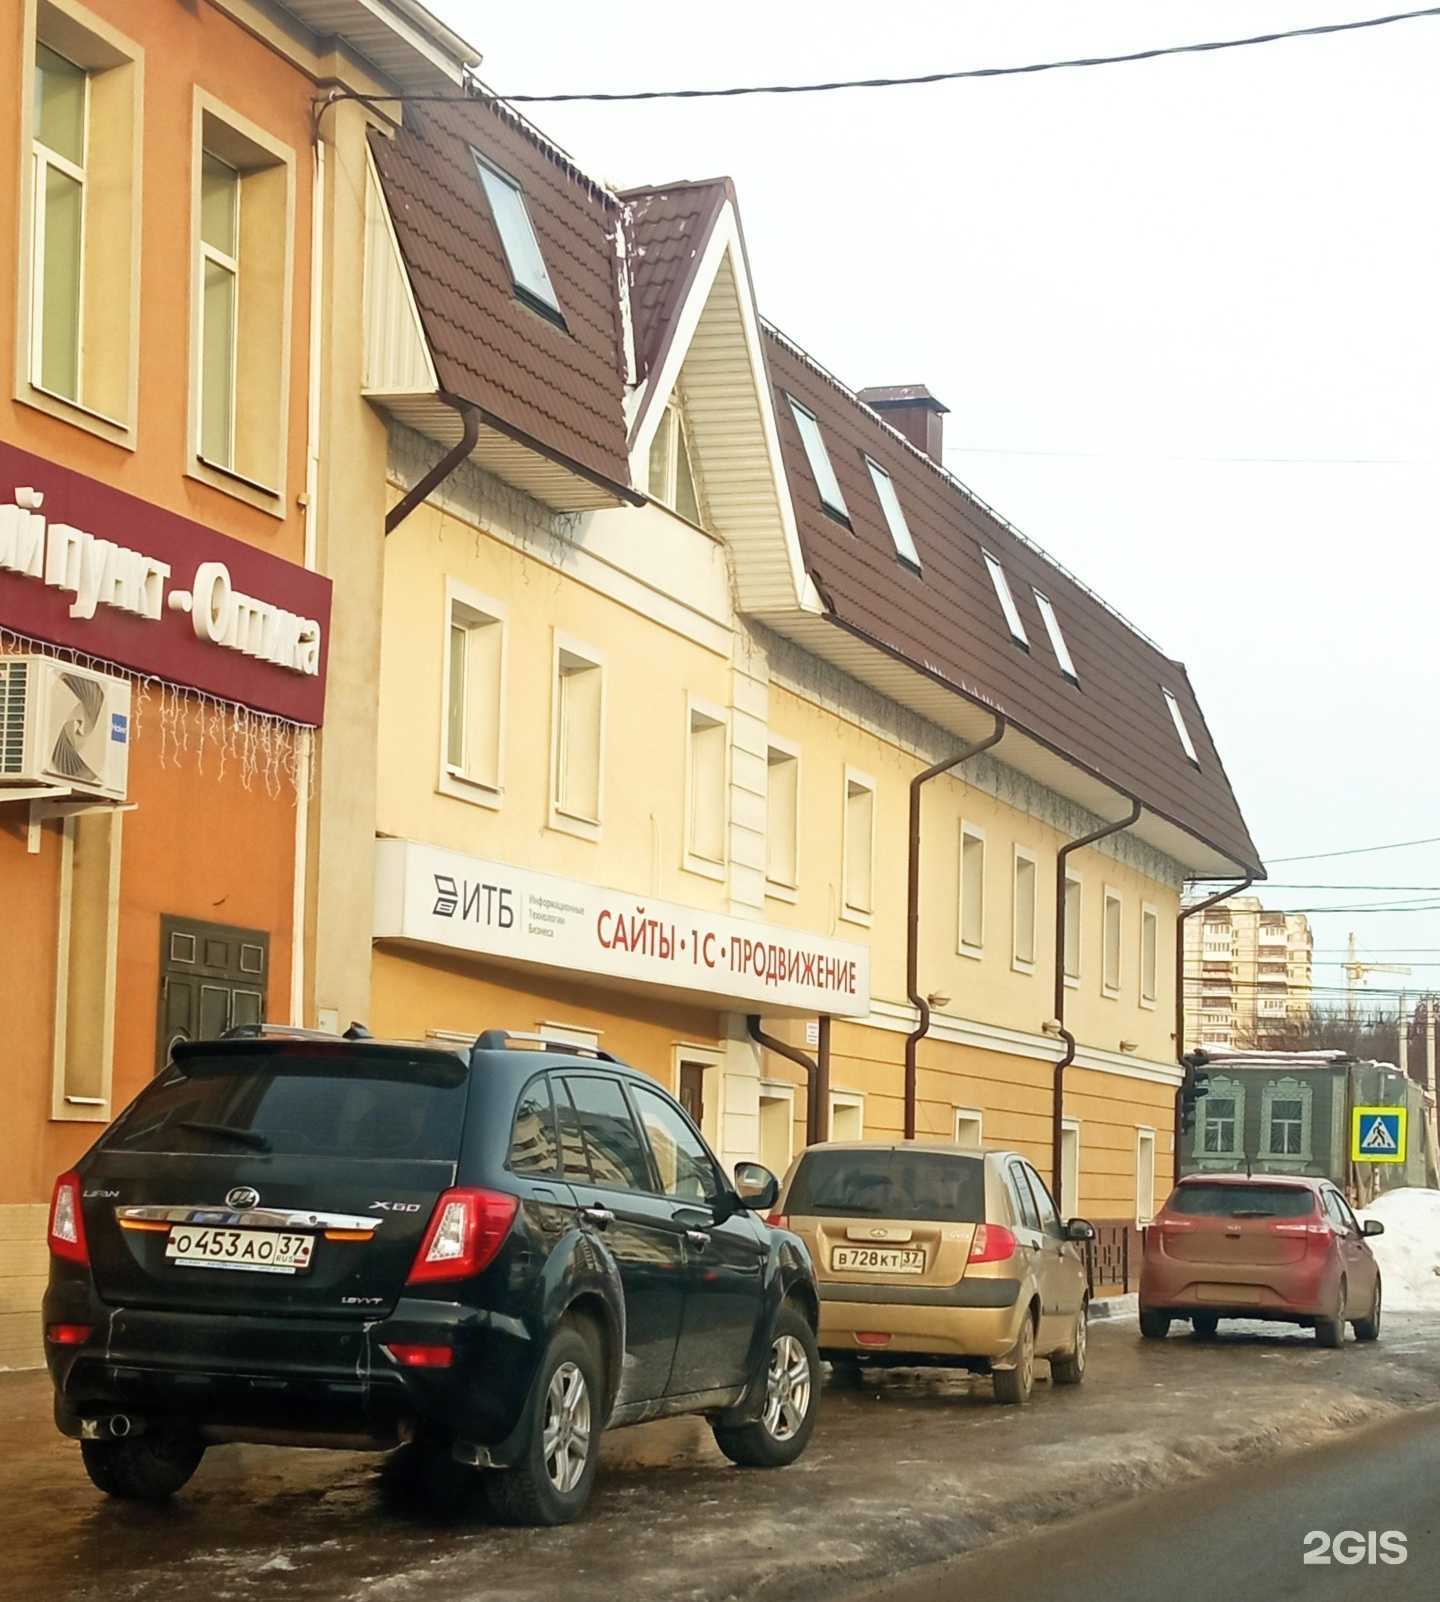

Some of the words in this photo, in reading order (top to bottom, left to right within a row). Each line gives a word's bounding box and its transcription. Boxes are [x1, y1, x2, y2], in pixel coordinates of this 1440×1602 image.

[462, 879, 514, 928] ИТБ
[597, 906, 675, 961] САЙТЫ
[730, 936, 857, 994] ПРОДВИЖЕНИЕ
